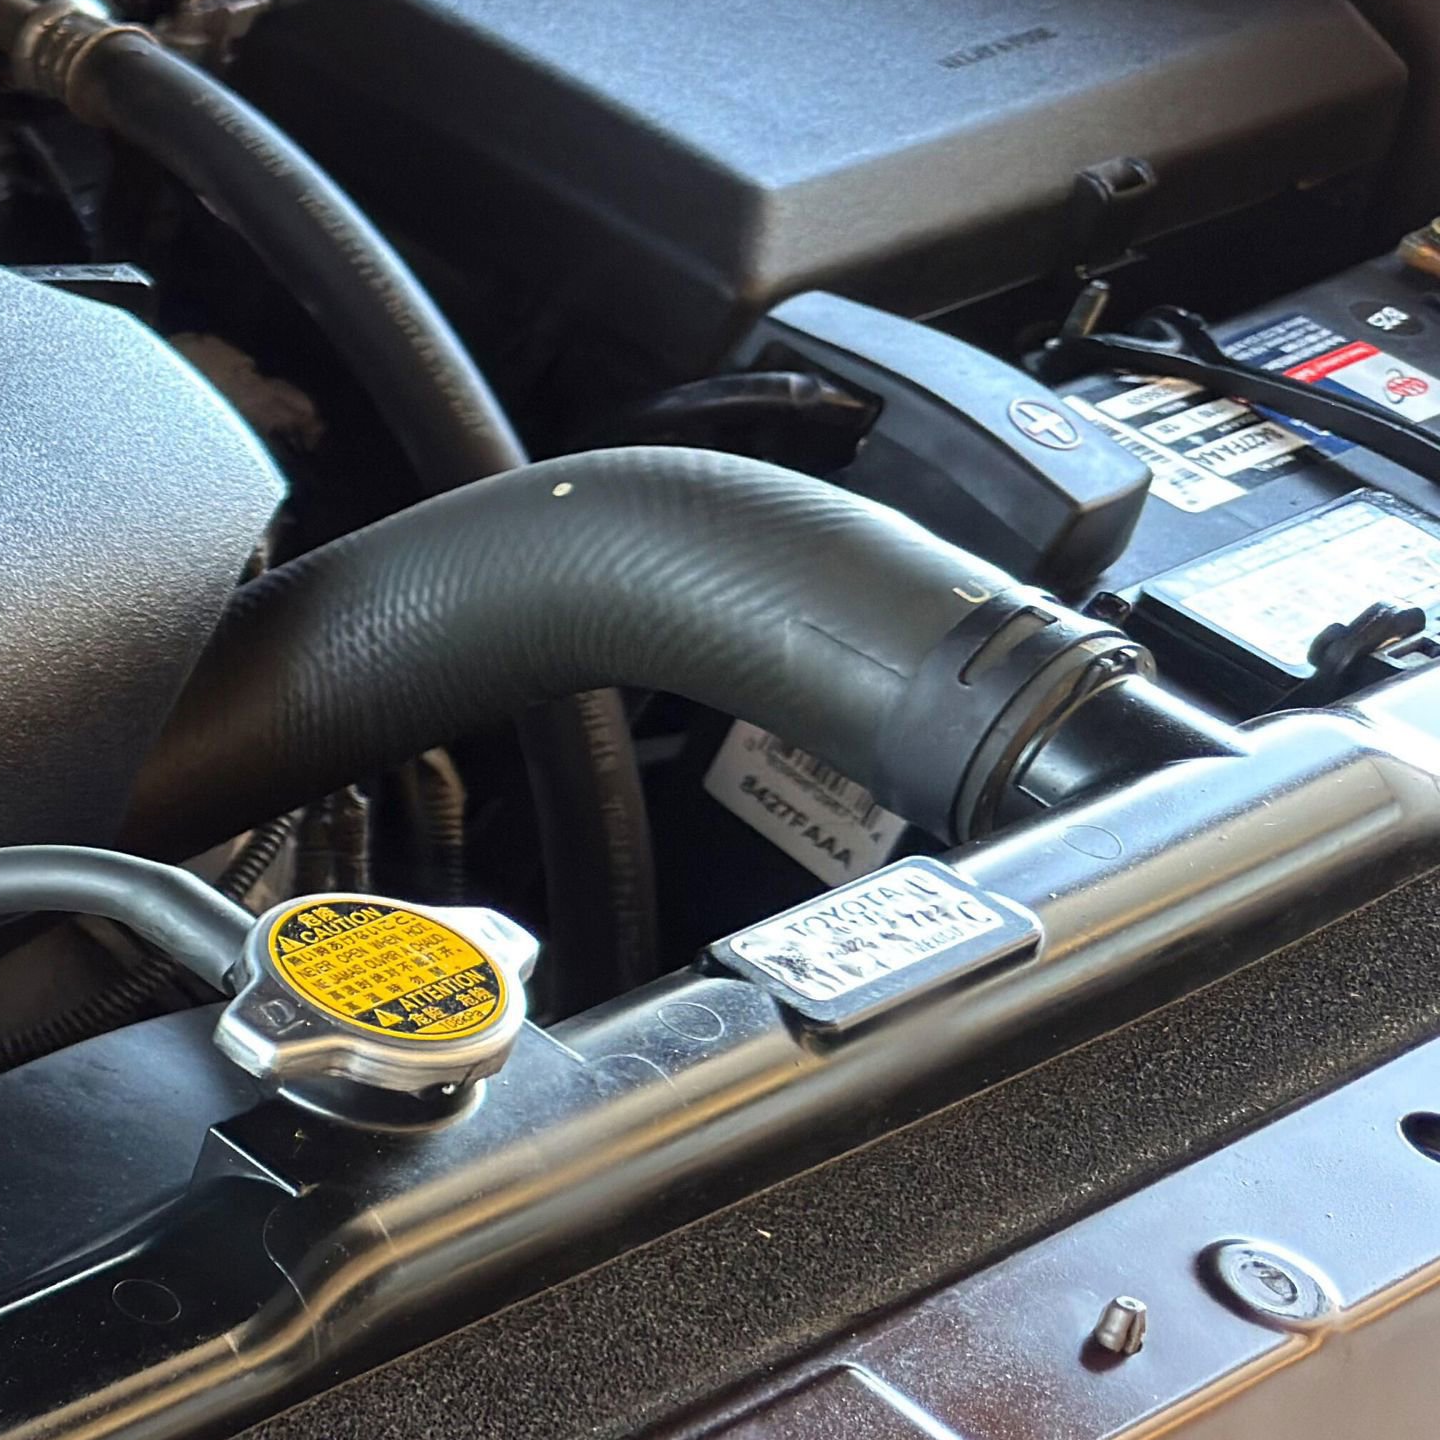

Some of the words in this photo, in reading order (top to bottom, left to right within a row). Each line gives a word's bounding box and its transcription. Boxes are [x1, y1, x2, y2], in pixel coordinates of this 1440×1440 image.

[300, 906, 383, 944] CAUTION
[784, 885, 904, 937] TOYOTA
[296, 960, 336, 980] NEVER
[335, 946, 370, 964] OPEN
[370, 933, 404, 951] WHEN
[398, 968, 487, 1012] ATTENTION
